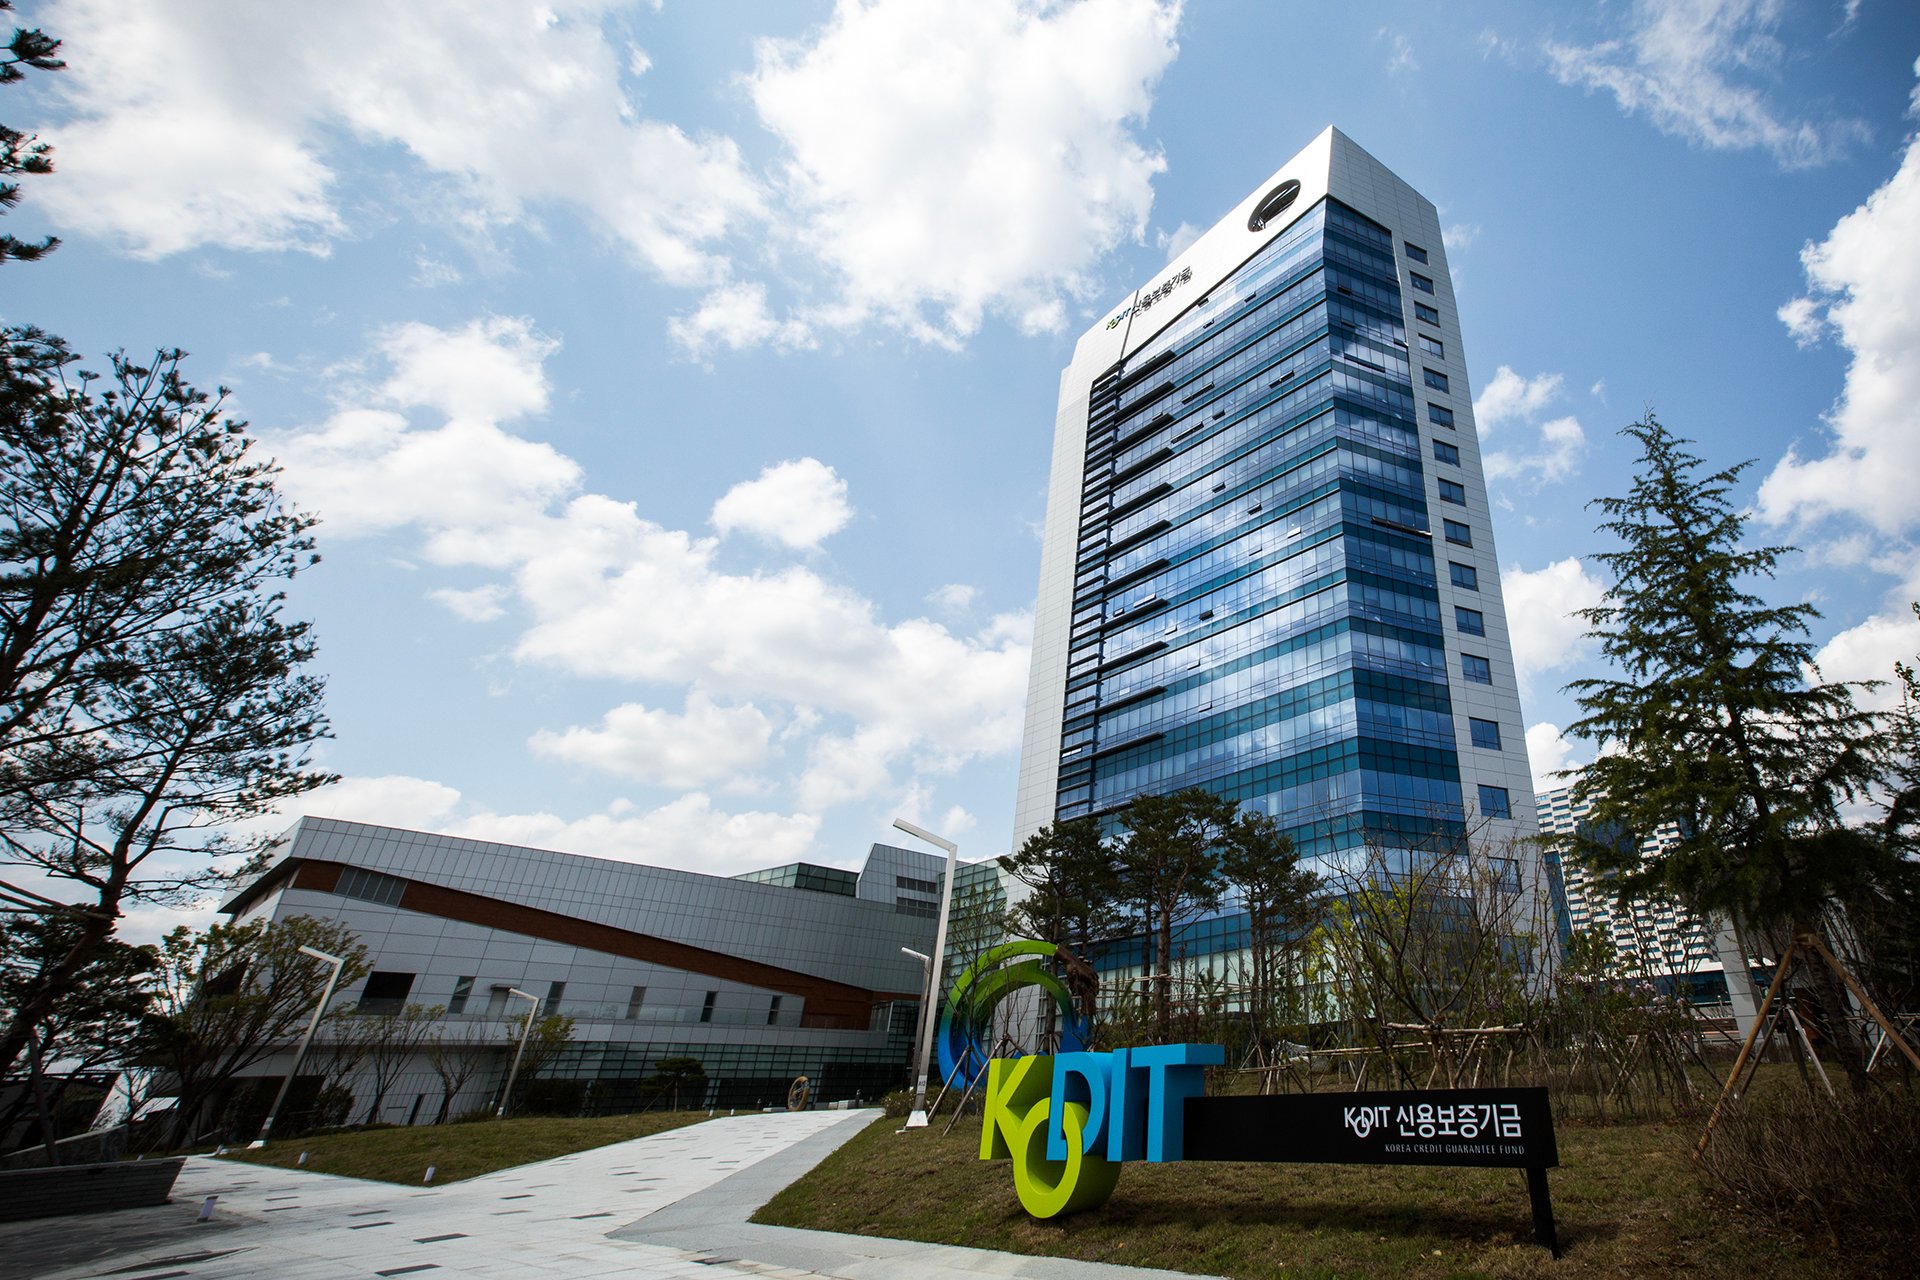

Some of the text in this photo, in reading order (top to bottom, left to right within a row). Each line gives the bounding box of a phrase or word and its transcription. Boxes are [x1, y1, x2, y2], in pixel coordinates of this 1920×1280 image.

[979, 1043, 1225, 1218] KODIT
[1344, 1103, 1522, 1138] KODIT 신용보증기금
[1385, 1144, 1525, 1155] KOREA CREDIT GUARANTEE FUND
